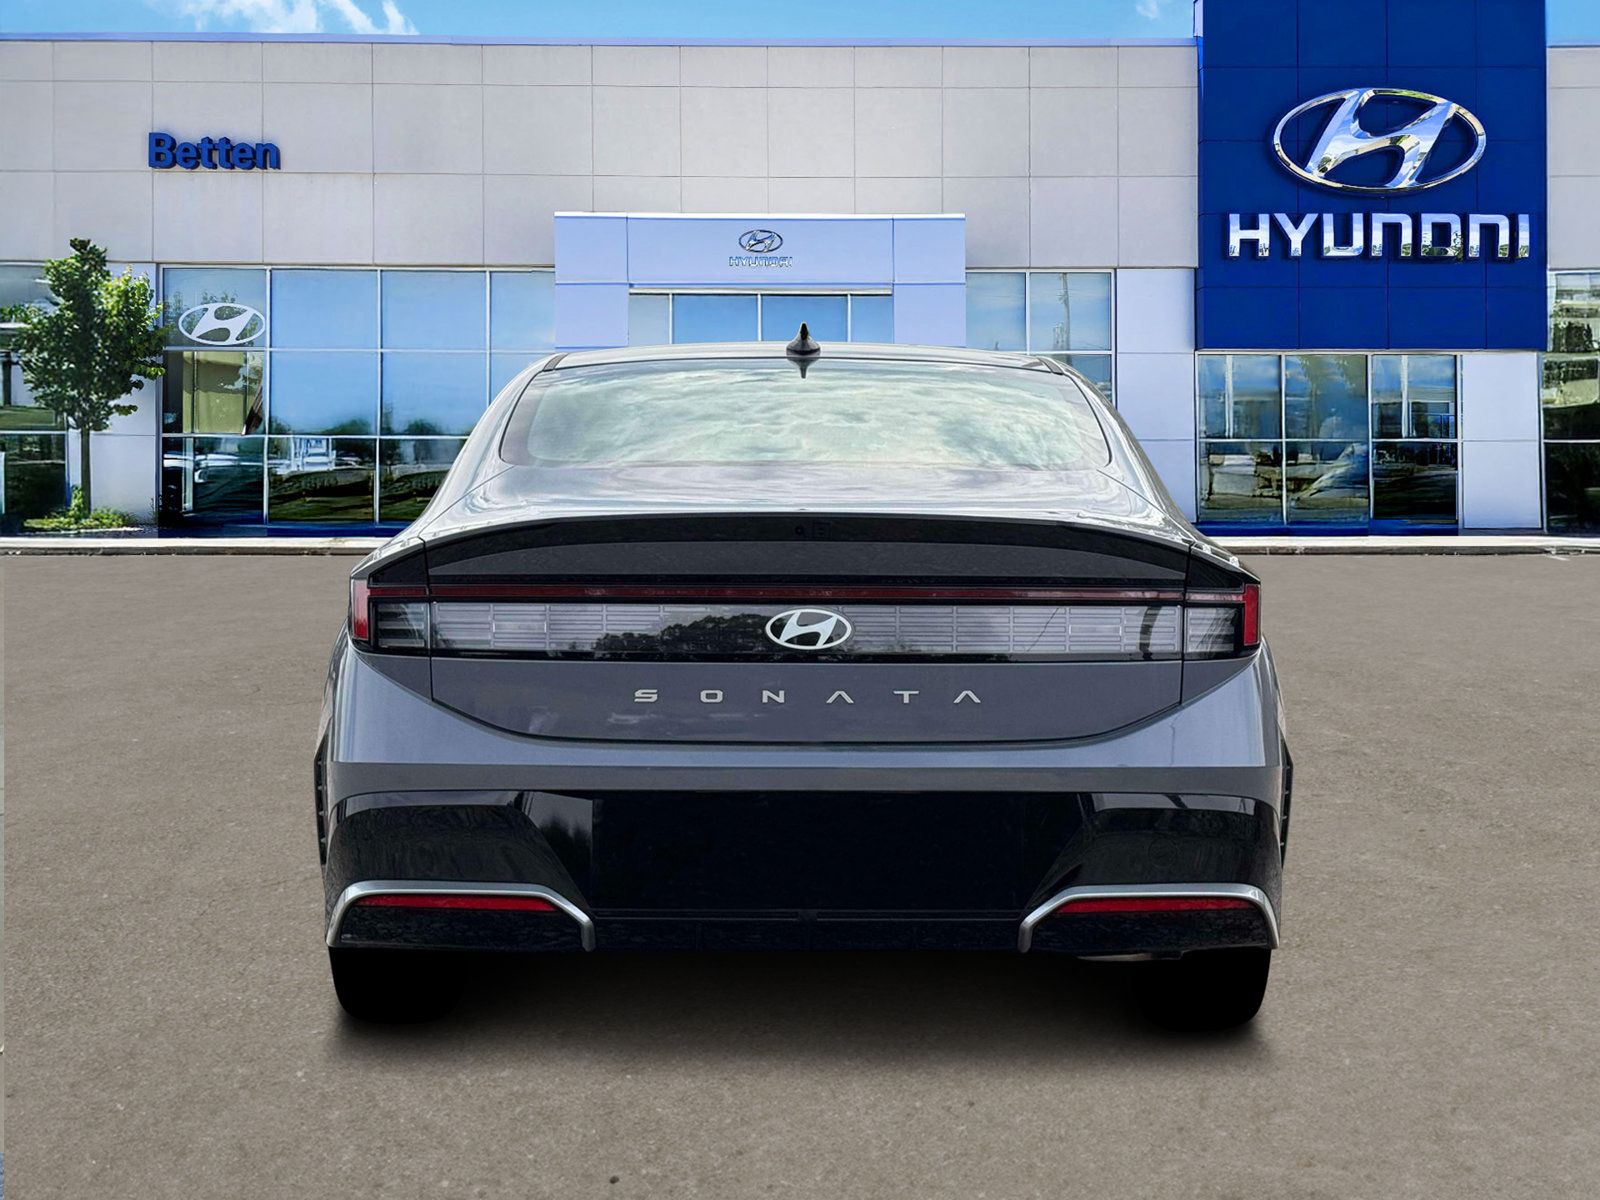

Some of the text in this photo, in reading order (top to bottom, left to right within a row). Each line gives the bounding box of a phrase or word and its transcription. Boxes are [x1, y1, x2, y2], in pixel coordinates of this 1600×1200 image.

[148, 132, 281, 170] Betten
[1229, 213, 1530, 258] HYUNDAI
[634, 689, 982, 704] SONATA
